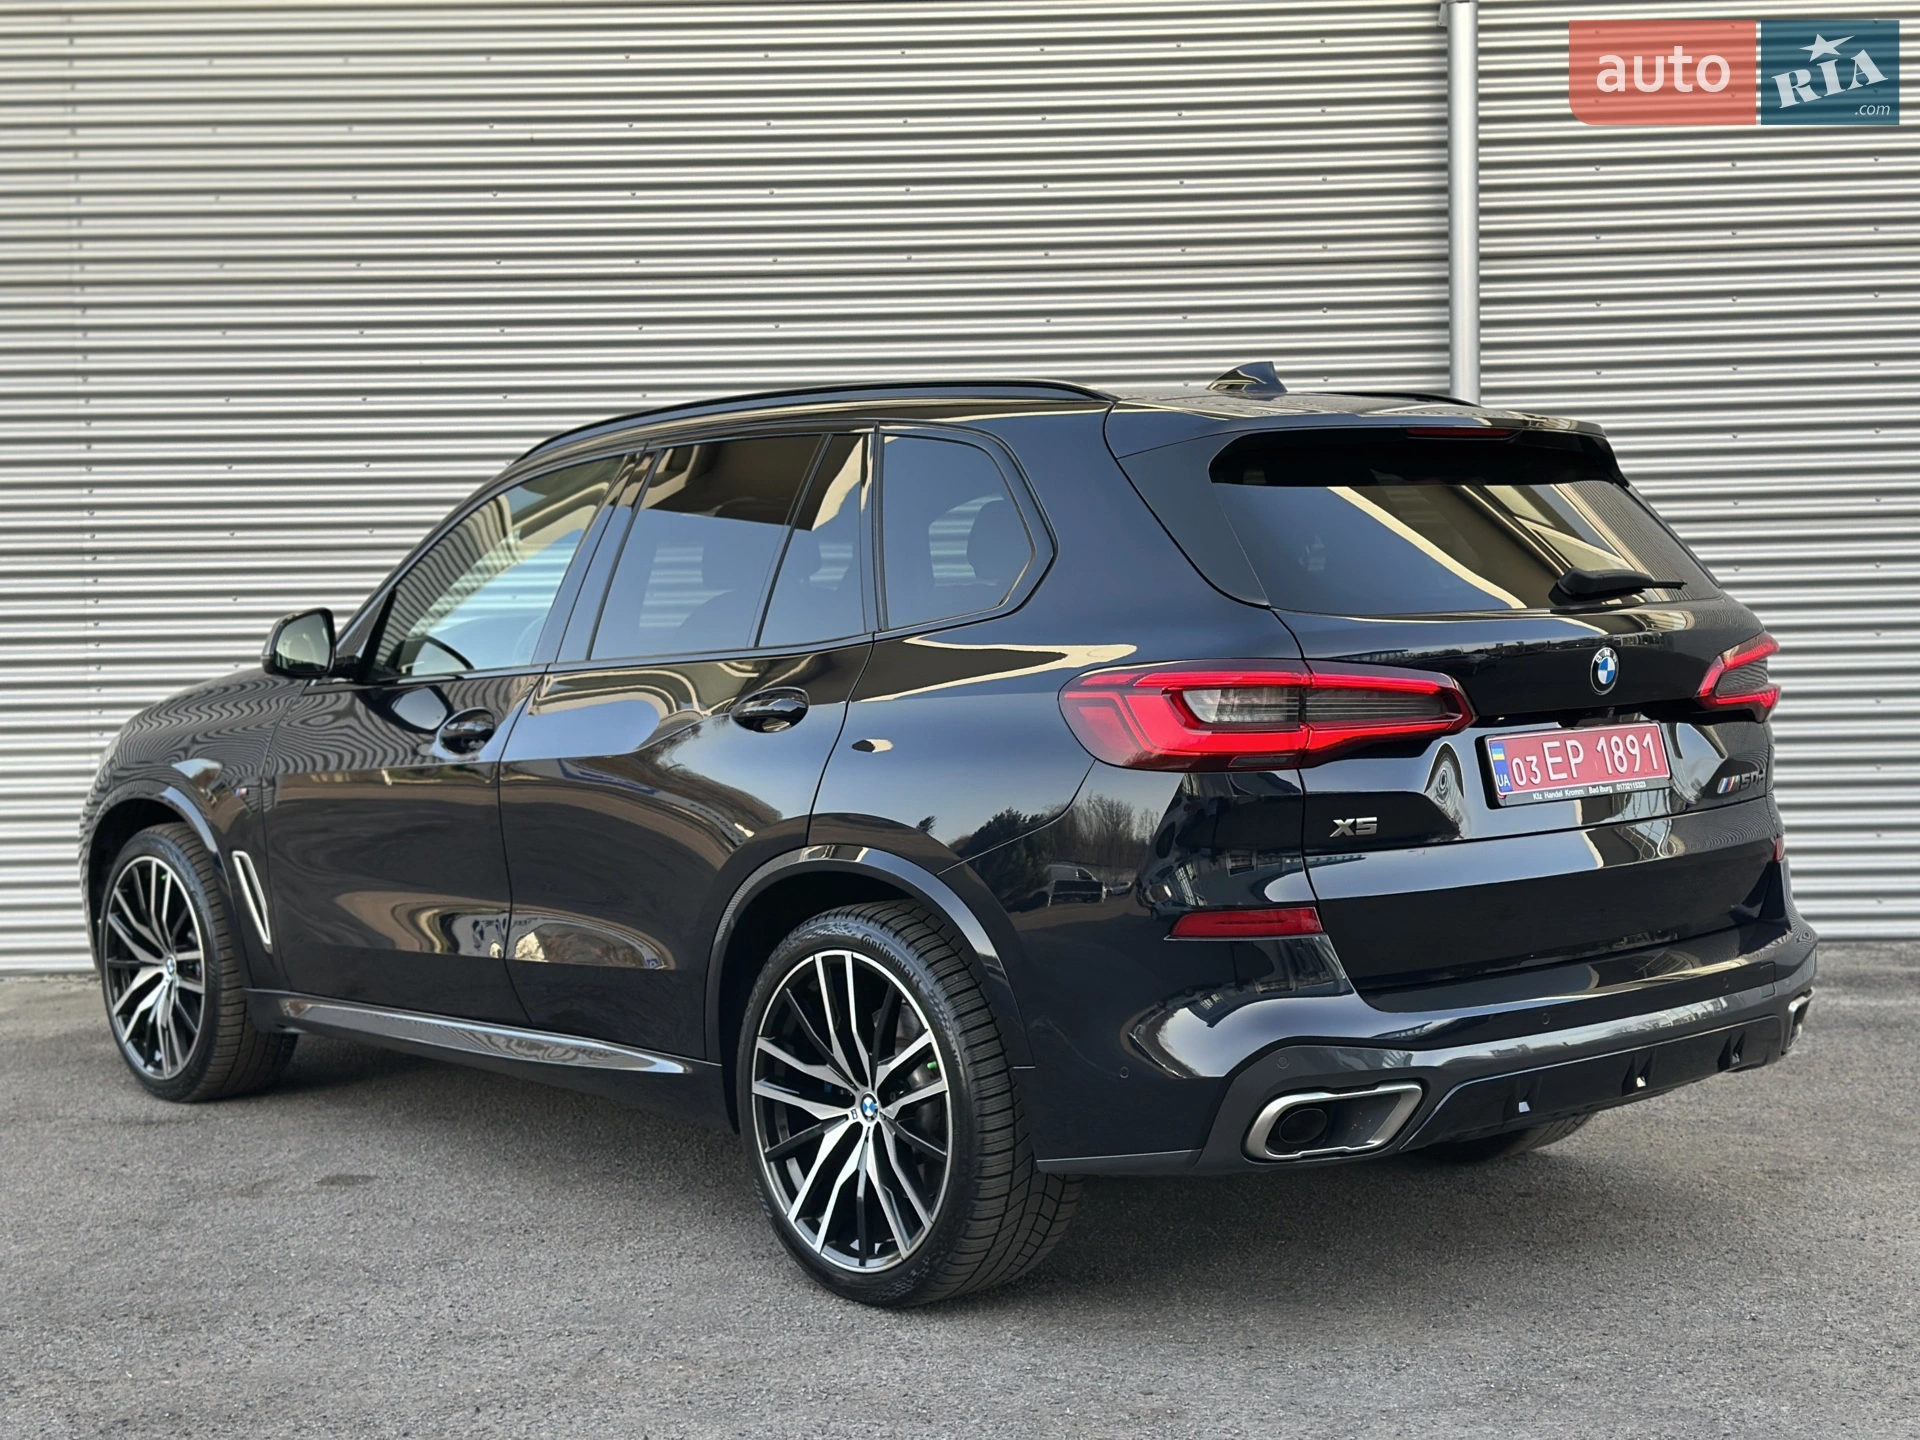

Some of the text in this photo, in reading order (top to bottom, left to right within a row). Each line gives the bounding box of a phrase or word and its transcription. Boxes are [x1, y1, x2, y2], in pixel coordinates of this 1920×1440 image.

[1511, 733, 1659, 786] 03 EP 1891
[1498, 773, 1511, 787] UA
[1588, 786, 1599, 794] Bad
[1329, 816, 1378, 838] X5
